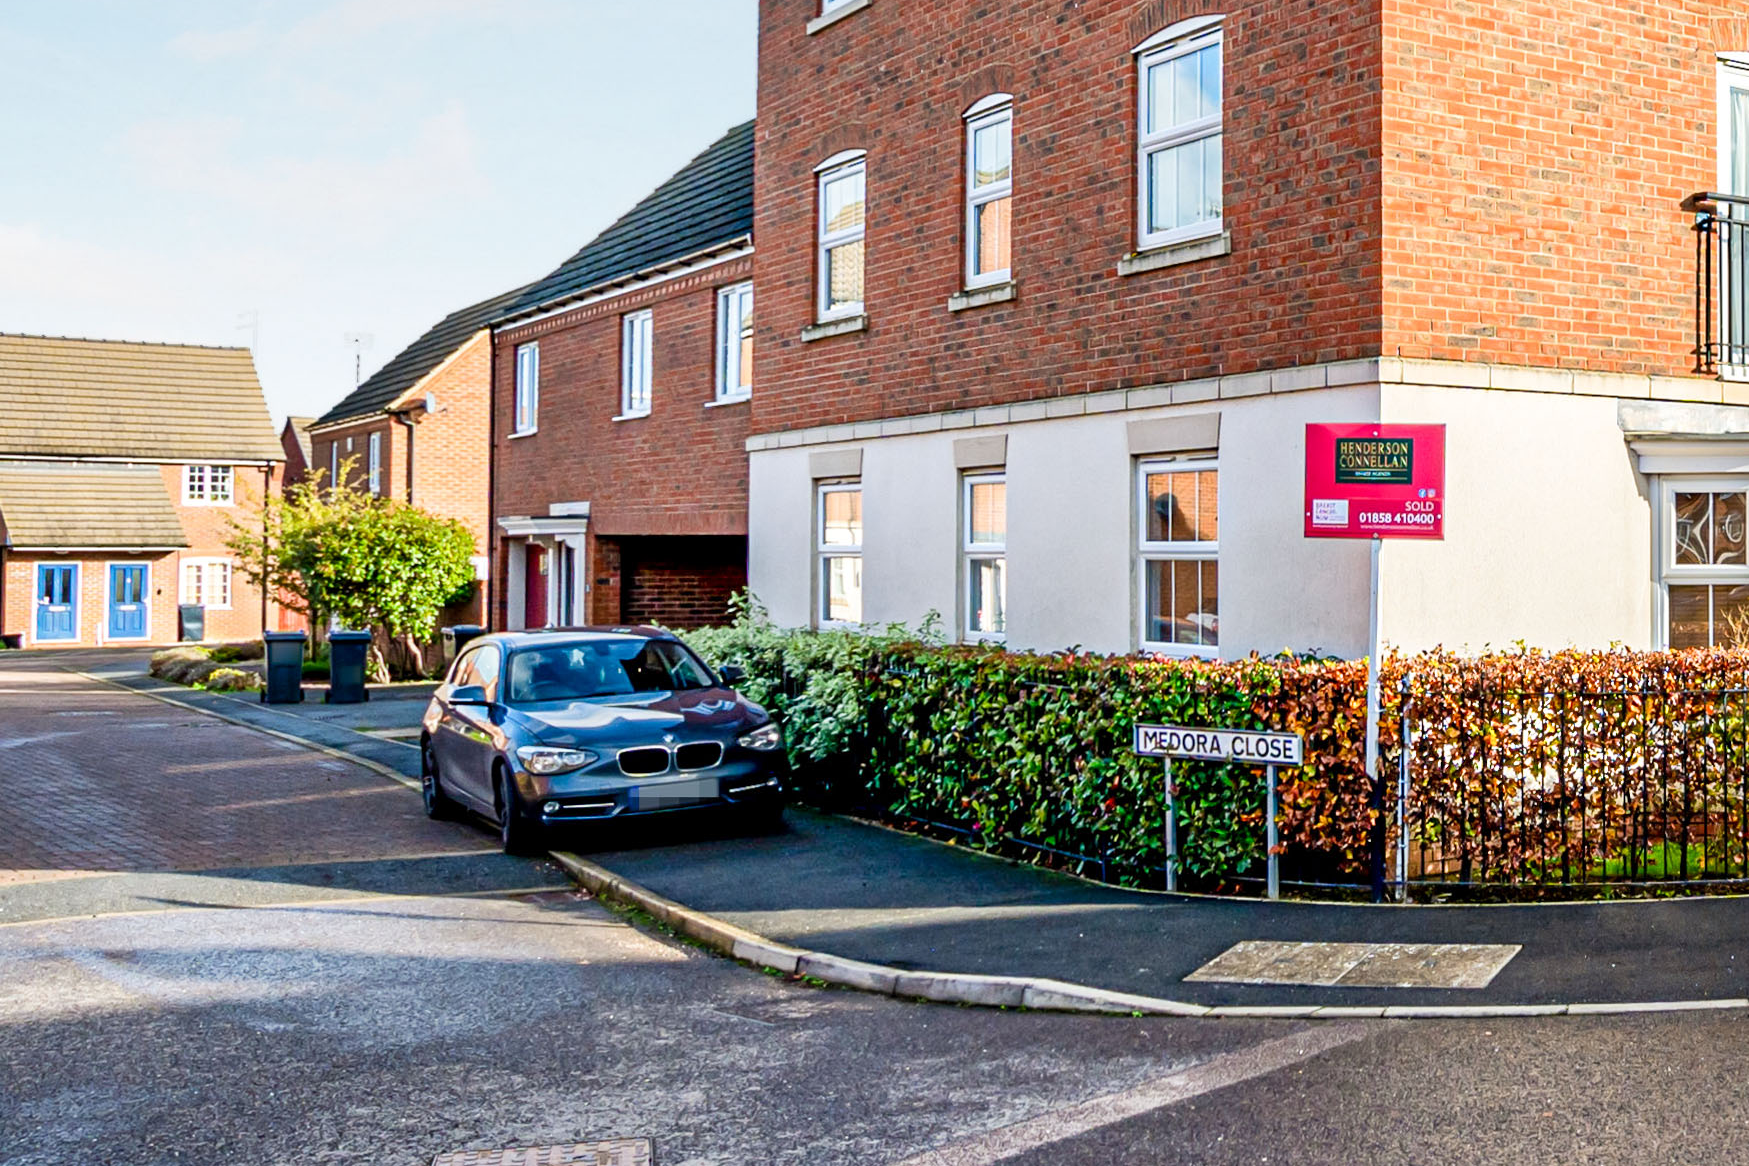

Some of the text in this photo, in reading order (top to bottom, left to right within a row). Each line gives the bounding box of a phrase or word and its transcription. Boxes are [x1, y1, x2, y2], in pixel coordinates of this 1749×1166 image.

[1340, 441, 1409, 455] HENDERSON
[1339, 455, 1408, 468] CONNELLAN
[1405, 501, 1435, 512] SOLD
[1359, 512, 1392, 524] 01858
[1393, 513, 1435, 524] 410400
[1143, 730, 1294, 760] MEDORA CLOSE
